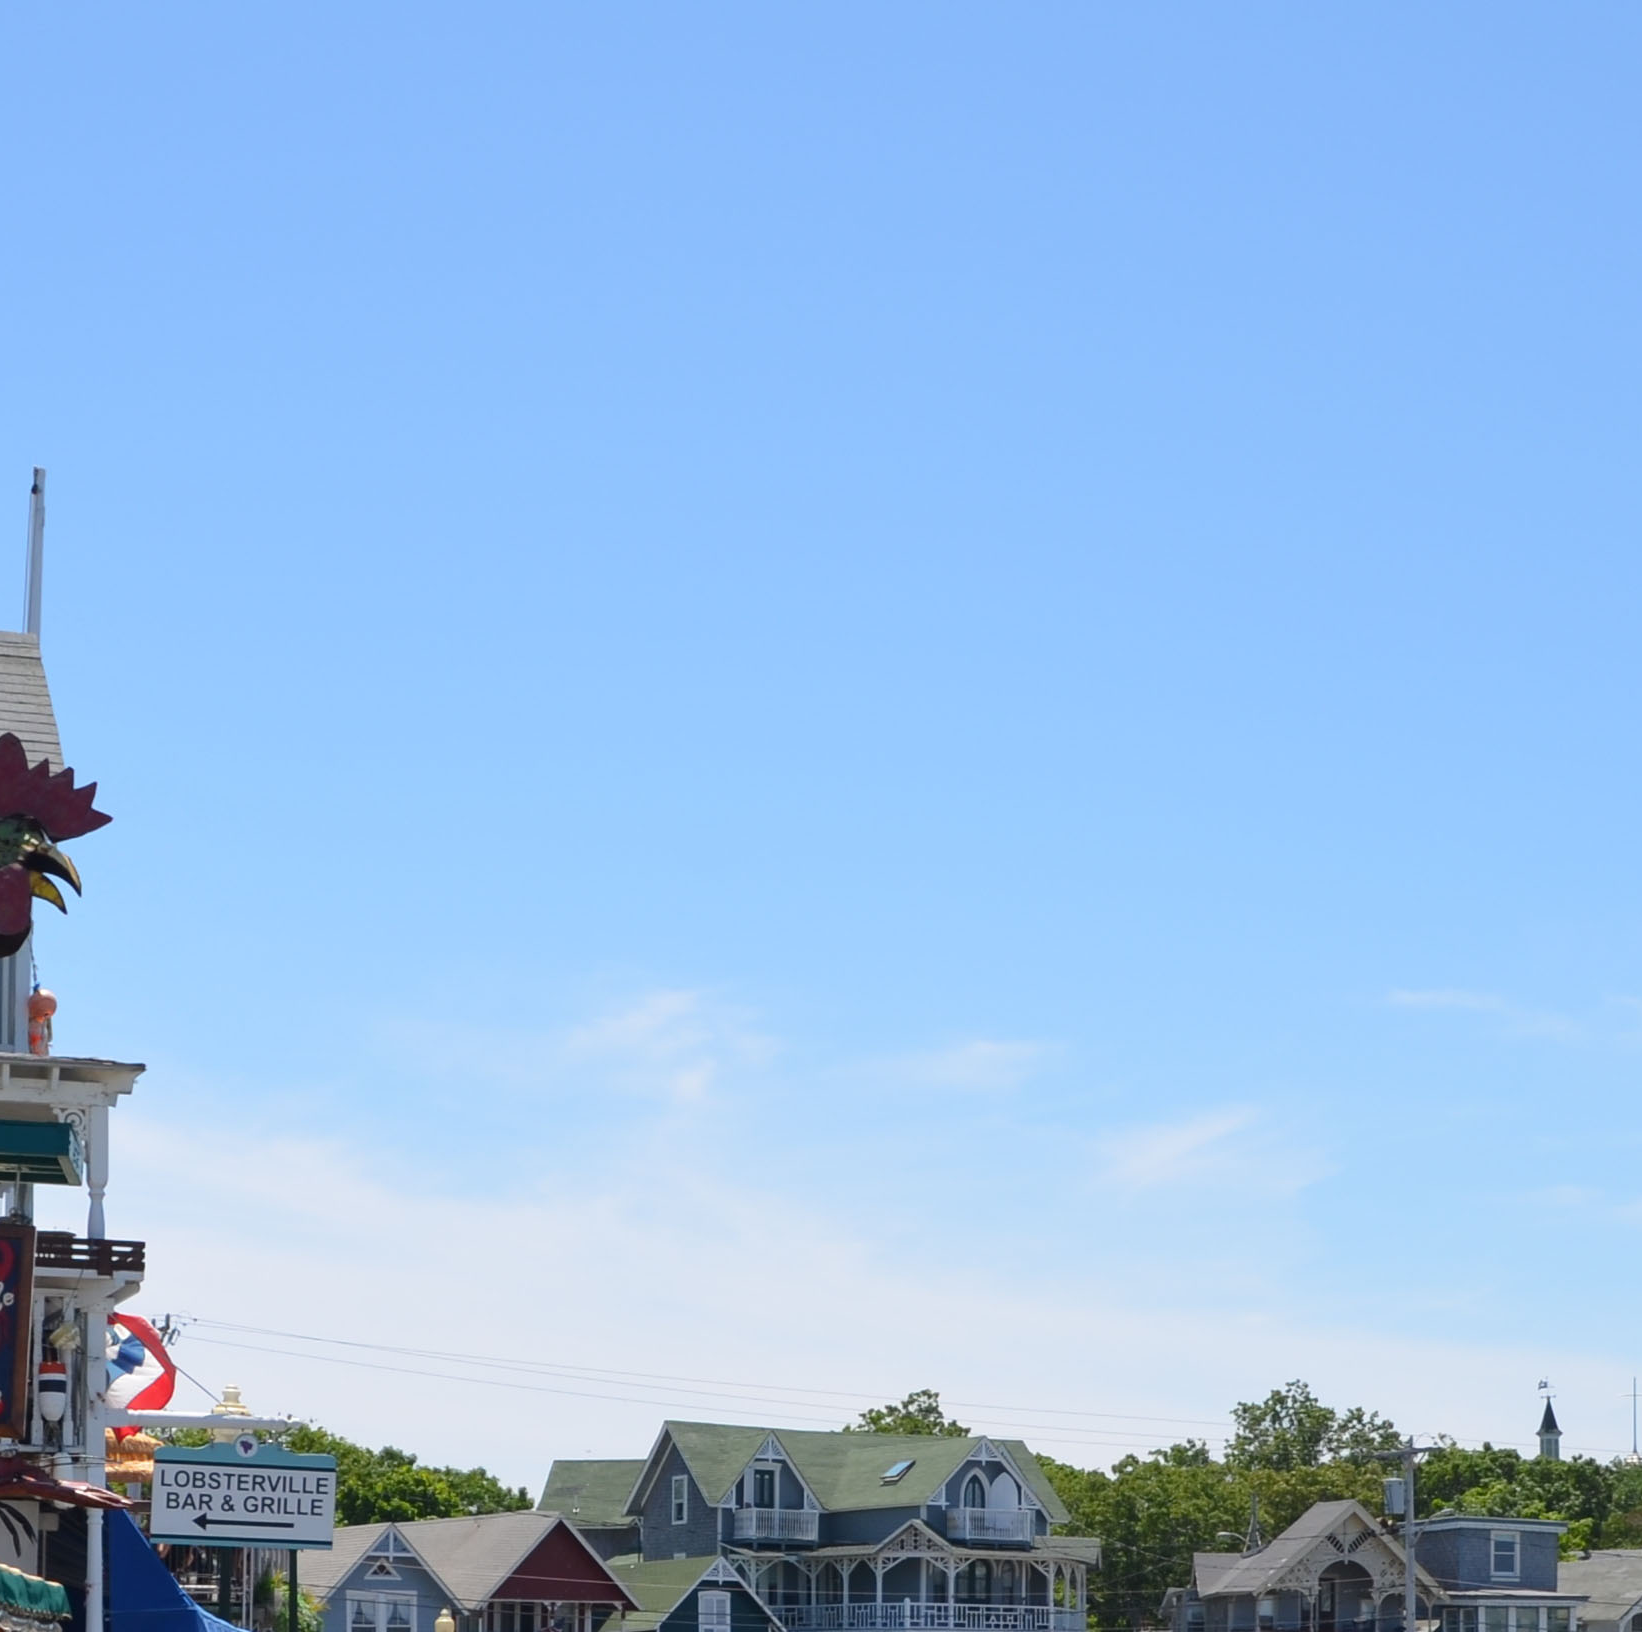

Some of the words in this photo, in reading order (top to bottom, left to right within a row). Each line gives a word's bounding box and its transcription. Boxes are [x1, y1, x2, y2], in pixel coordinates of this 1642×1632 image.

[160, 1469, 329, 1495] LOBSTERVILLE
[166, 1492, 213, 1511] BAR
[220, 1495, 235, 1512] &
[243, 1496, 324, 1516] GRILLE
